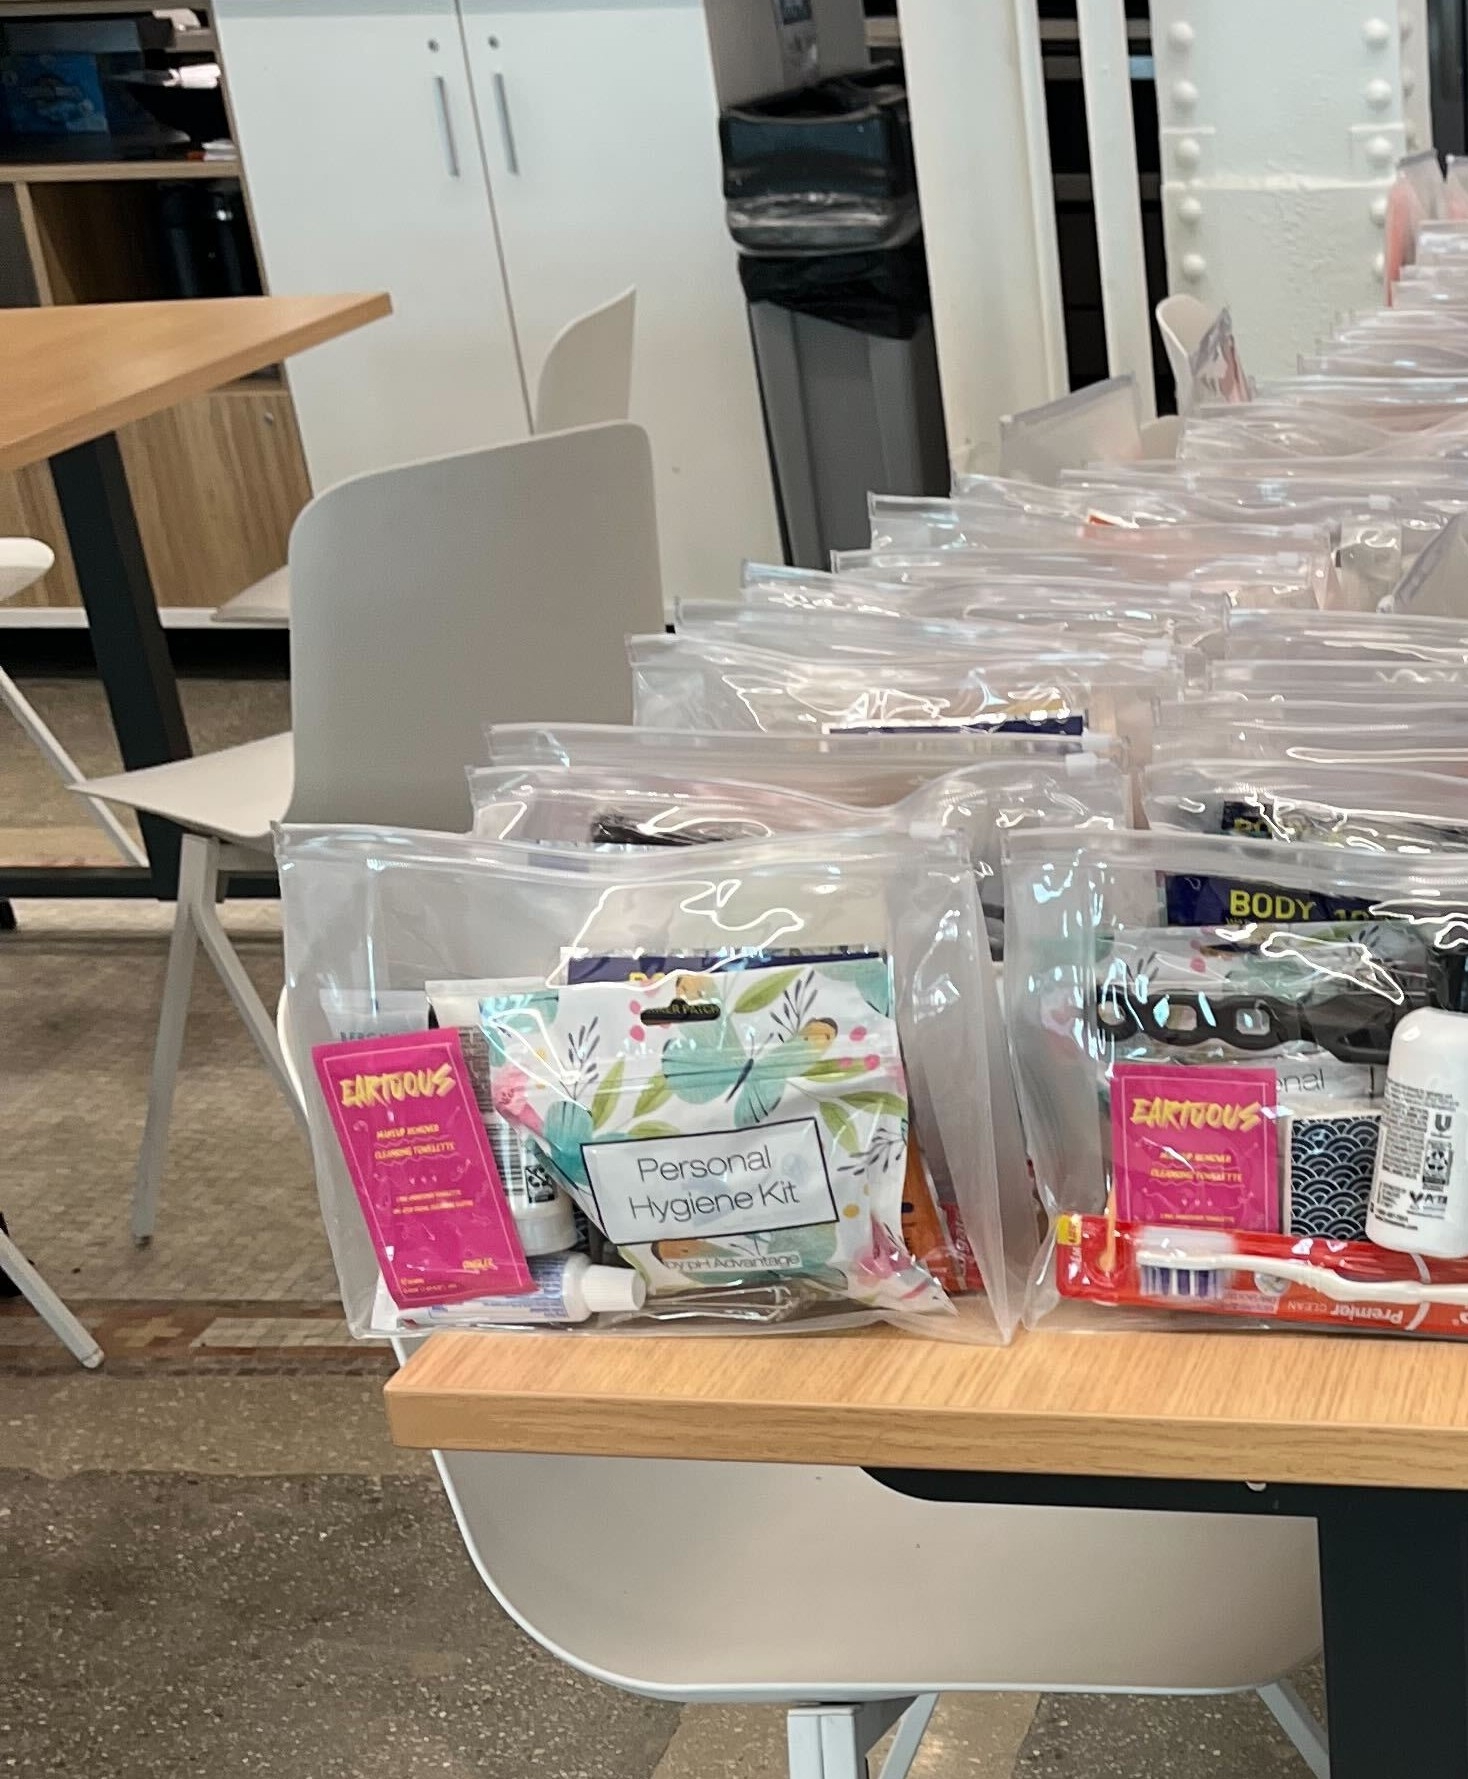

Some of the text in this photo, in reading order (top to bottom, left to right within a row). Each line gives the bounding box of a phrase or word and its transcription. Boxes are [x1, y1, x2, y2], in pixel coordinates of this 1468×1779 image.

[1229, 889, 1317, 920] BODY
[340, 1063, 457, 1108] EARTUOUS
[1129, 1096, 1262, 1132] EARTUOUS
[637, 1144, 773, 1182] Personal
[628, 1180, 801, 1223] Hygiene Kit
[711, 1251, 801, 1269] Advantage
[1330, 1303, 1404, 1326] Premier
